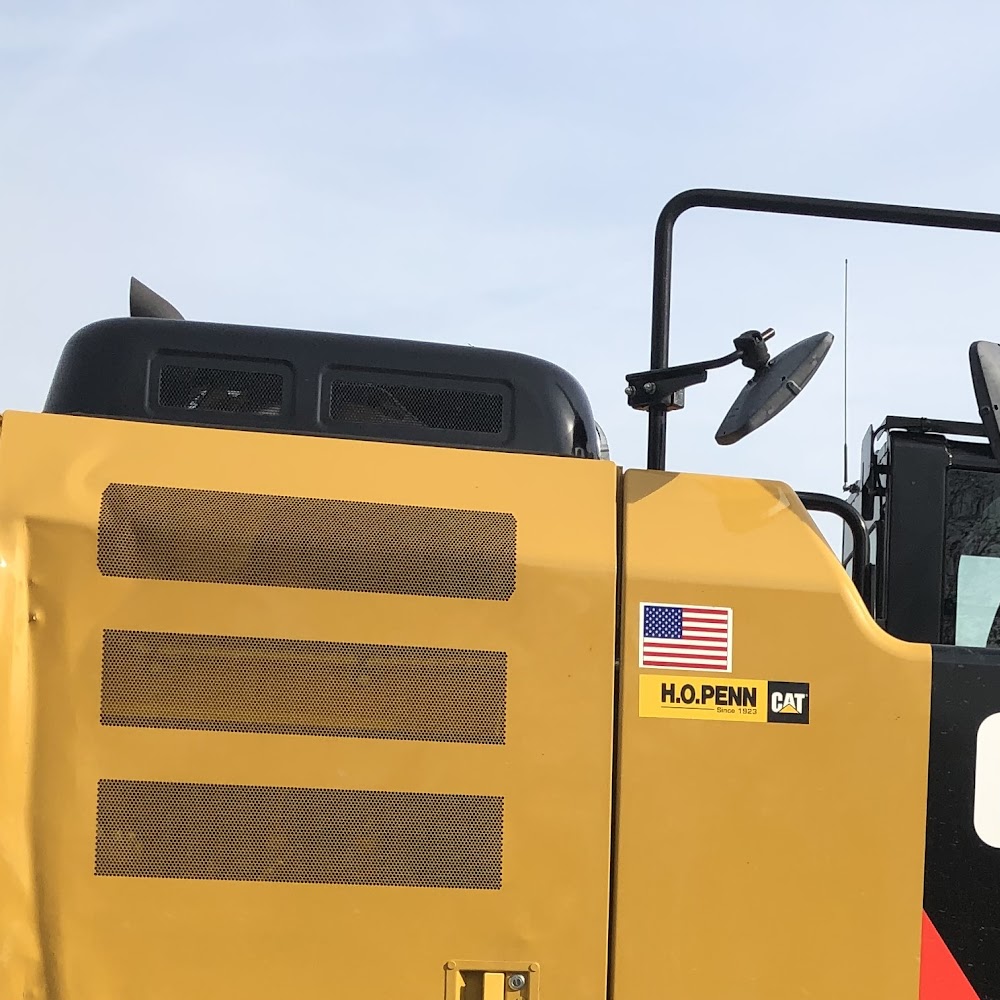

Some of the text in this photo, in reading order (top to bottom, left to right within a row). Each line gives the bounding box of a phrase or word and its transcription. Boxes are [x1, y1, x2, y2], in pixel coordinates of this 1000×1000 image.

[661, 682, 757, 707] H.O.PENN
[771, 691, 806, 714] CAT
[716, 706, 735, 714] Since
